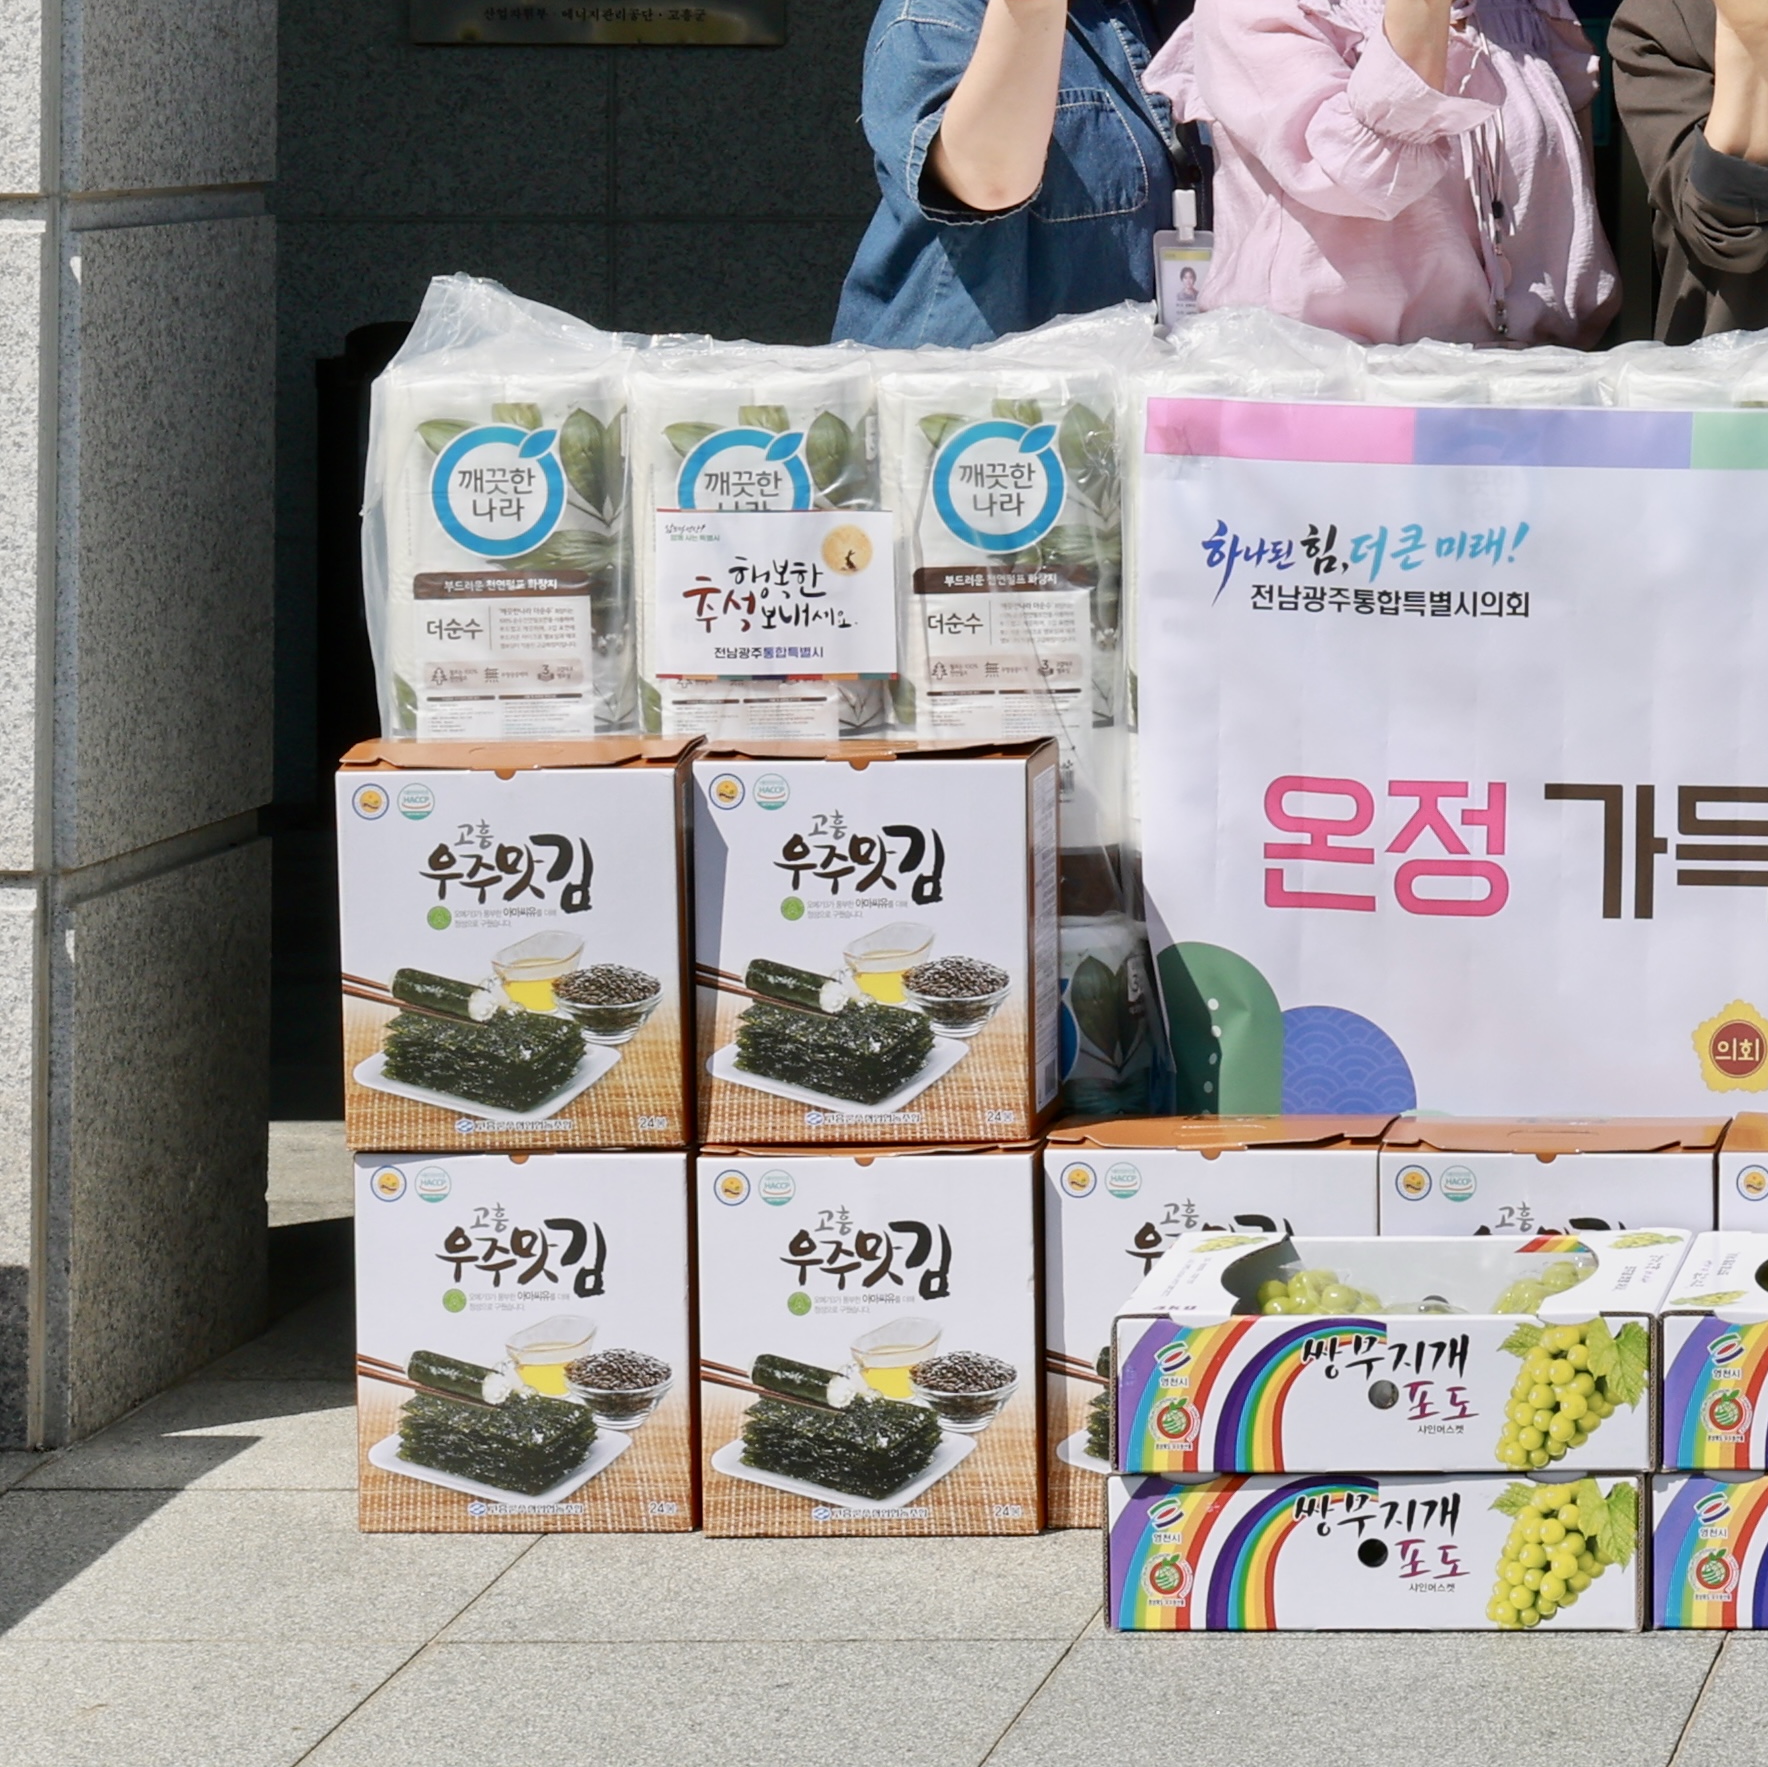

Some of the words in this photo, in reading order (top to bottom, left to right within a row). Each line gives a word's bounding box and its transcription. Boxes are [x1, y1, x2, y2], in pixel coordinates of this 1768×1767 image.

[458, 467, 535, 495] 깨끗한
[705, 471, 782, 498] 깨끗한
[959, 463, 1035, 490] 깨끗한
[472, 498, 525, 522] 나라
[973, 493, 1025, 517] 나라
[728, 556, 827, 598] 행복한
[1201, 520, 1296, 607] 하나된
[1300, 523, 1349, 576] 힘,
[1348, 525, 1388, 583] 더
[1391, 523, 1427, 571] 큰
[1435, 522, 1530, 567] 미래!
[443, 580, 484, 592] 부드러운
[943, 574, 984, 587] 부드러운
[682, 576, 756, 633] 추석
[1250, 584, 1530, 618] 전남광주통합특별시의회
[427, 619, 483, 640] 더순수
[927, 613, 983, 634] 더순수
[714, 646, 824, 659] 전남광주통합특별시
[454, 819, 494, 849] 고흥
[808, 810, 847, 840] 고흥
[1262, 774, 1511, 919] 온정
[419, 834, 593, 913] 우주맛김
[773, 825, 945, 903] 우주맛김
[1715, 1037, 1760, 1062] 의회
[469, 1203, 508, 1233] 고흥
[434, 1218, 606, 1296] 우주맛김
[779, 1221, 951, 1299] 우주맛김
[1302, 1333, 1470, 1379] 쌍무지개
[1407, 1380, 1479, 1422] 포도
[1417, 1423, 1465, 1435] 샤인머스켓
